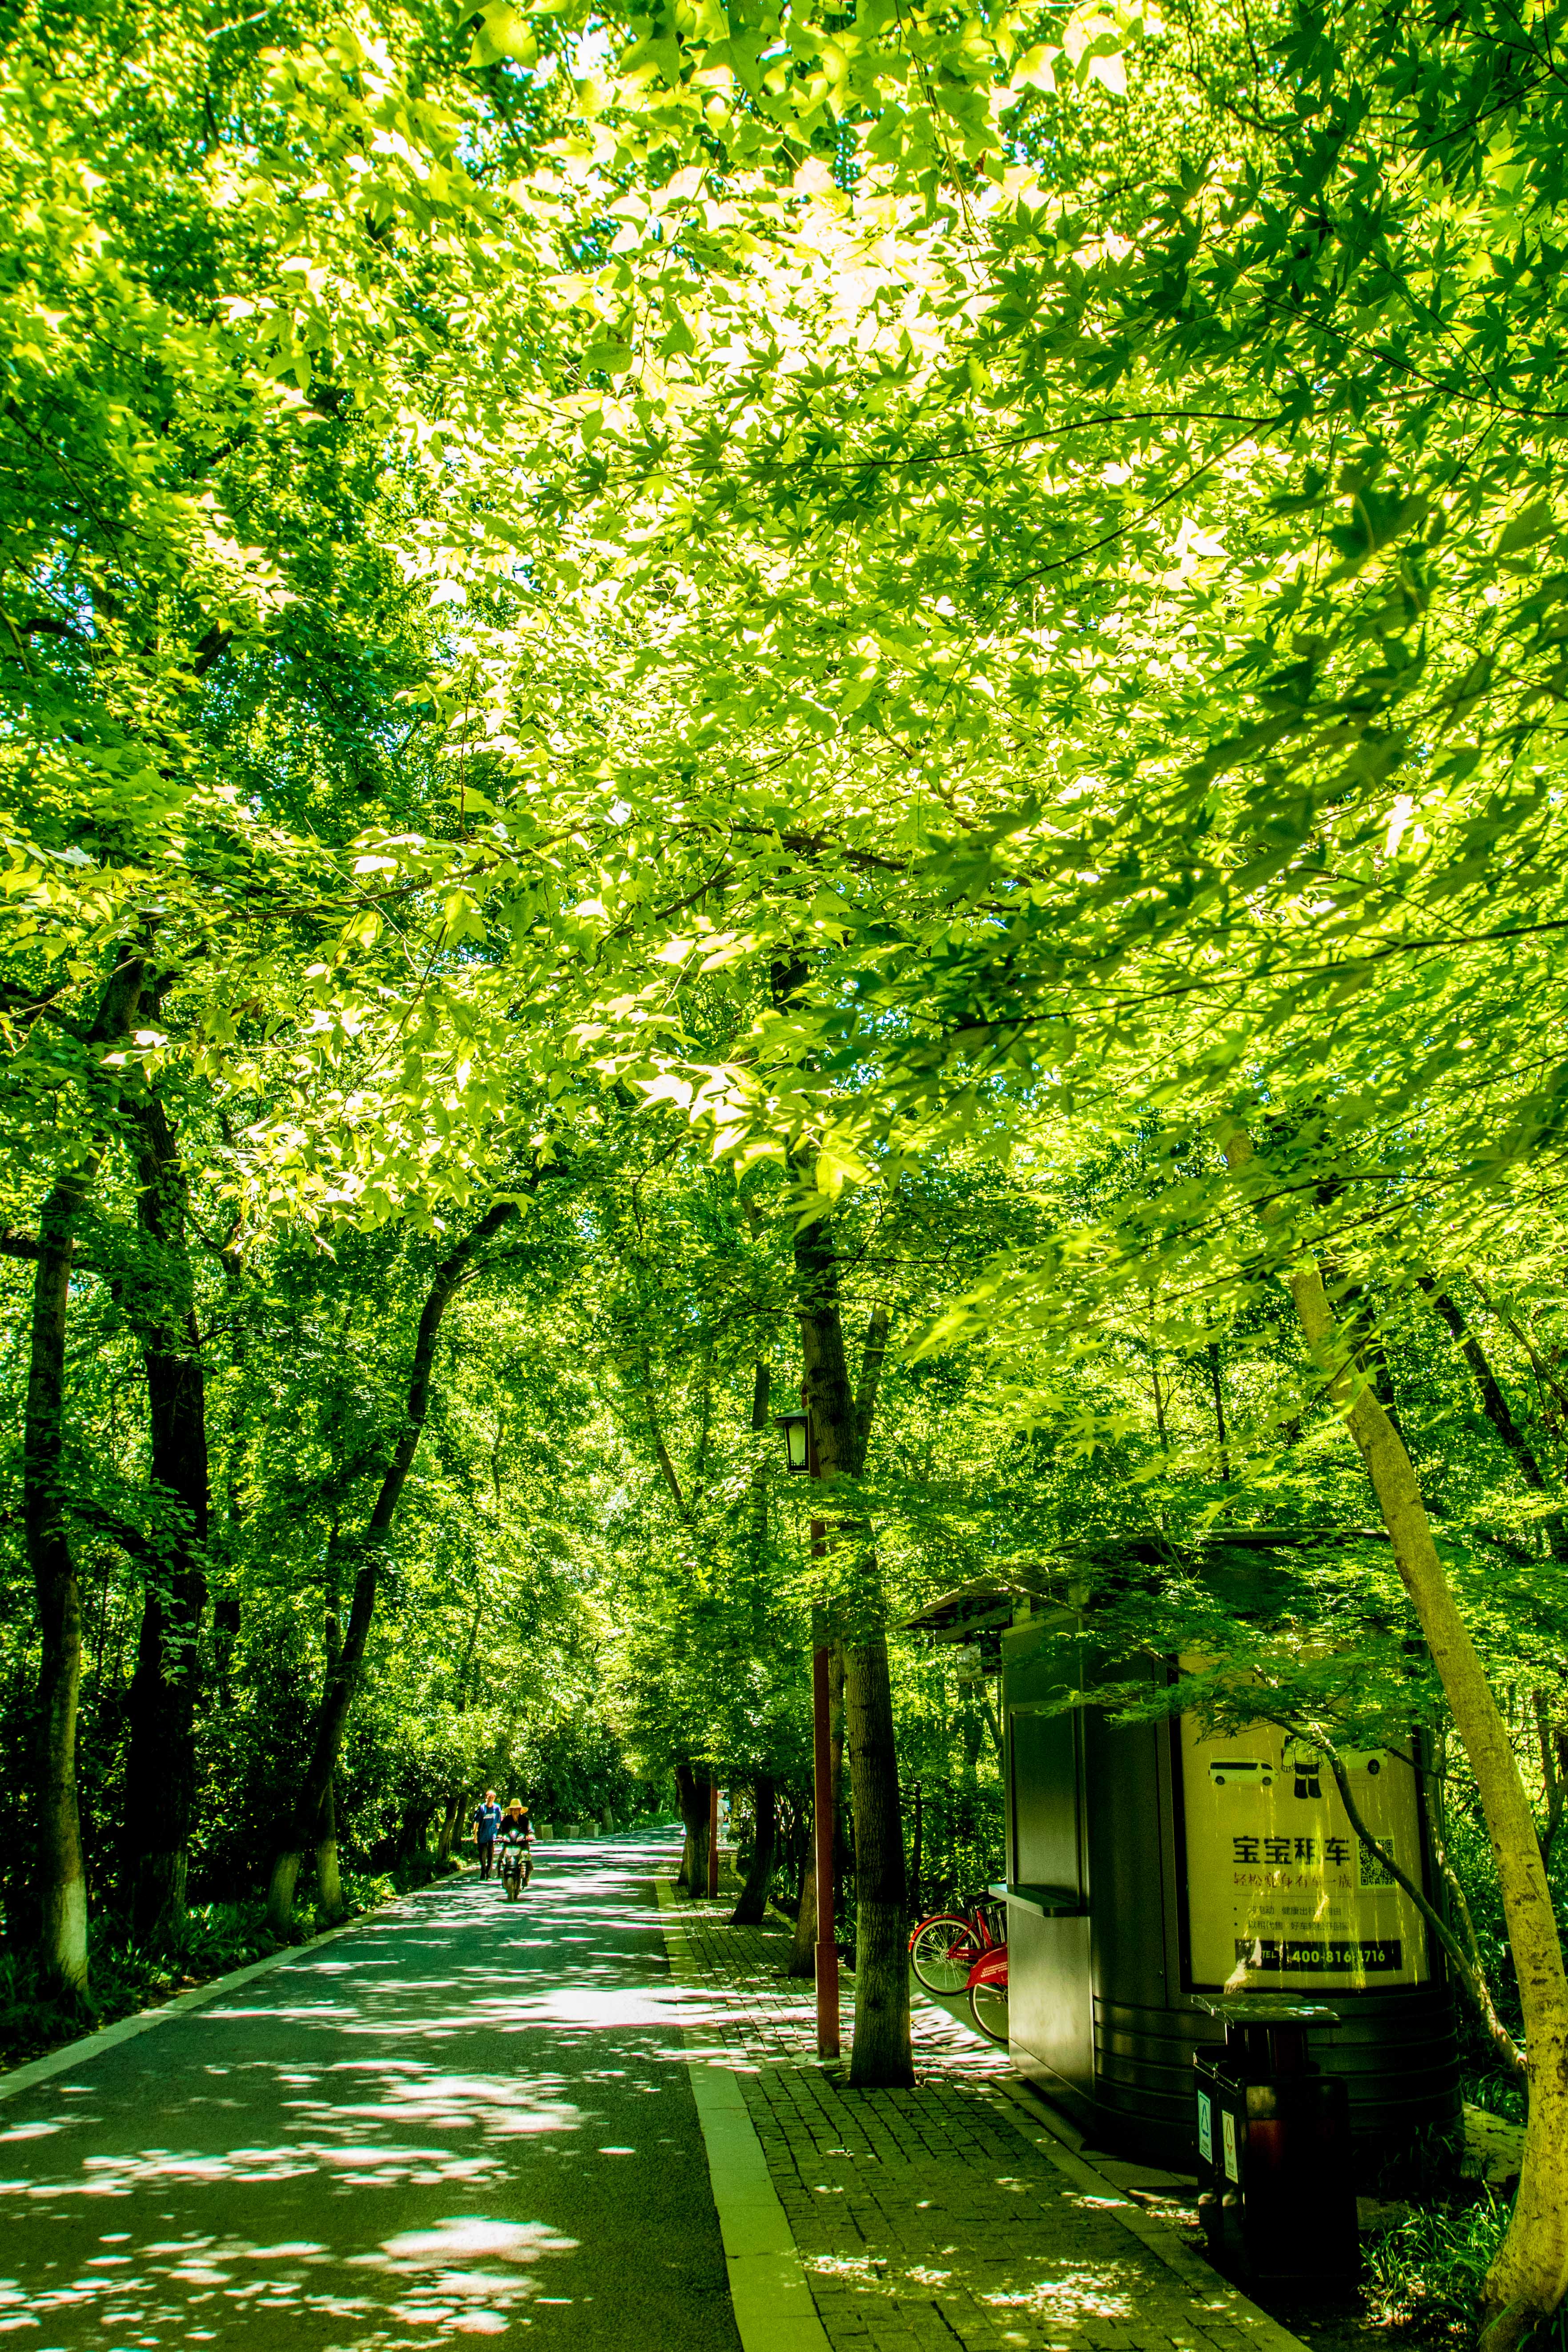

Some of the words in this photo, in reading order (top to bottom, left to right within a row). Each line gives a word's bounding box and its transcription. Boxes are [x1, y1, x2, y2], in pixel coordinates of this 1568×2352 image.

[1233, 1836, 1350, 1866] 宝宝租车
[1282, 1906, 1341, 1916] 健康出行自由
[1262, 1950, 1277, 1959] TEL
[1292, 1950, 1385, 1963] 400-816-1716
